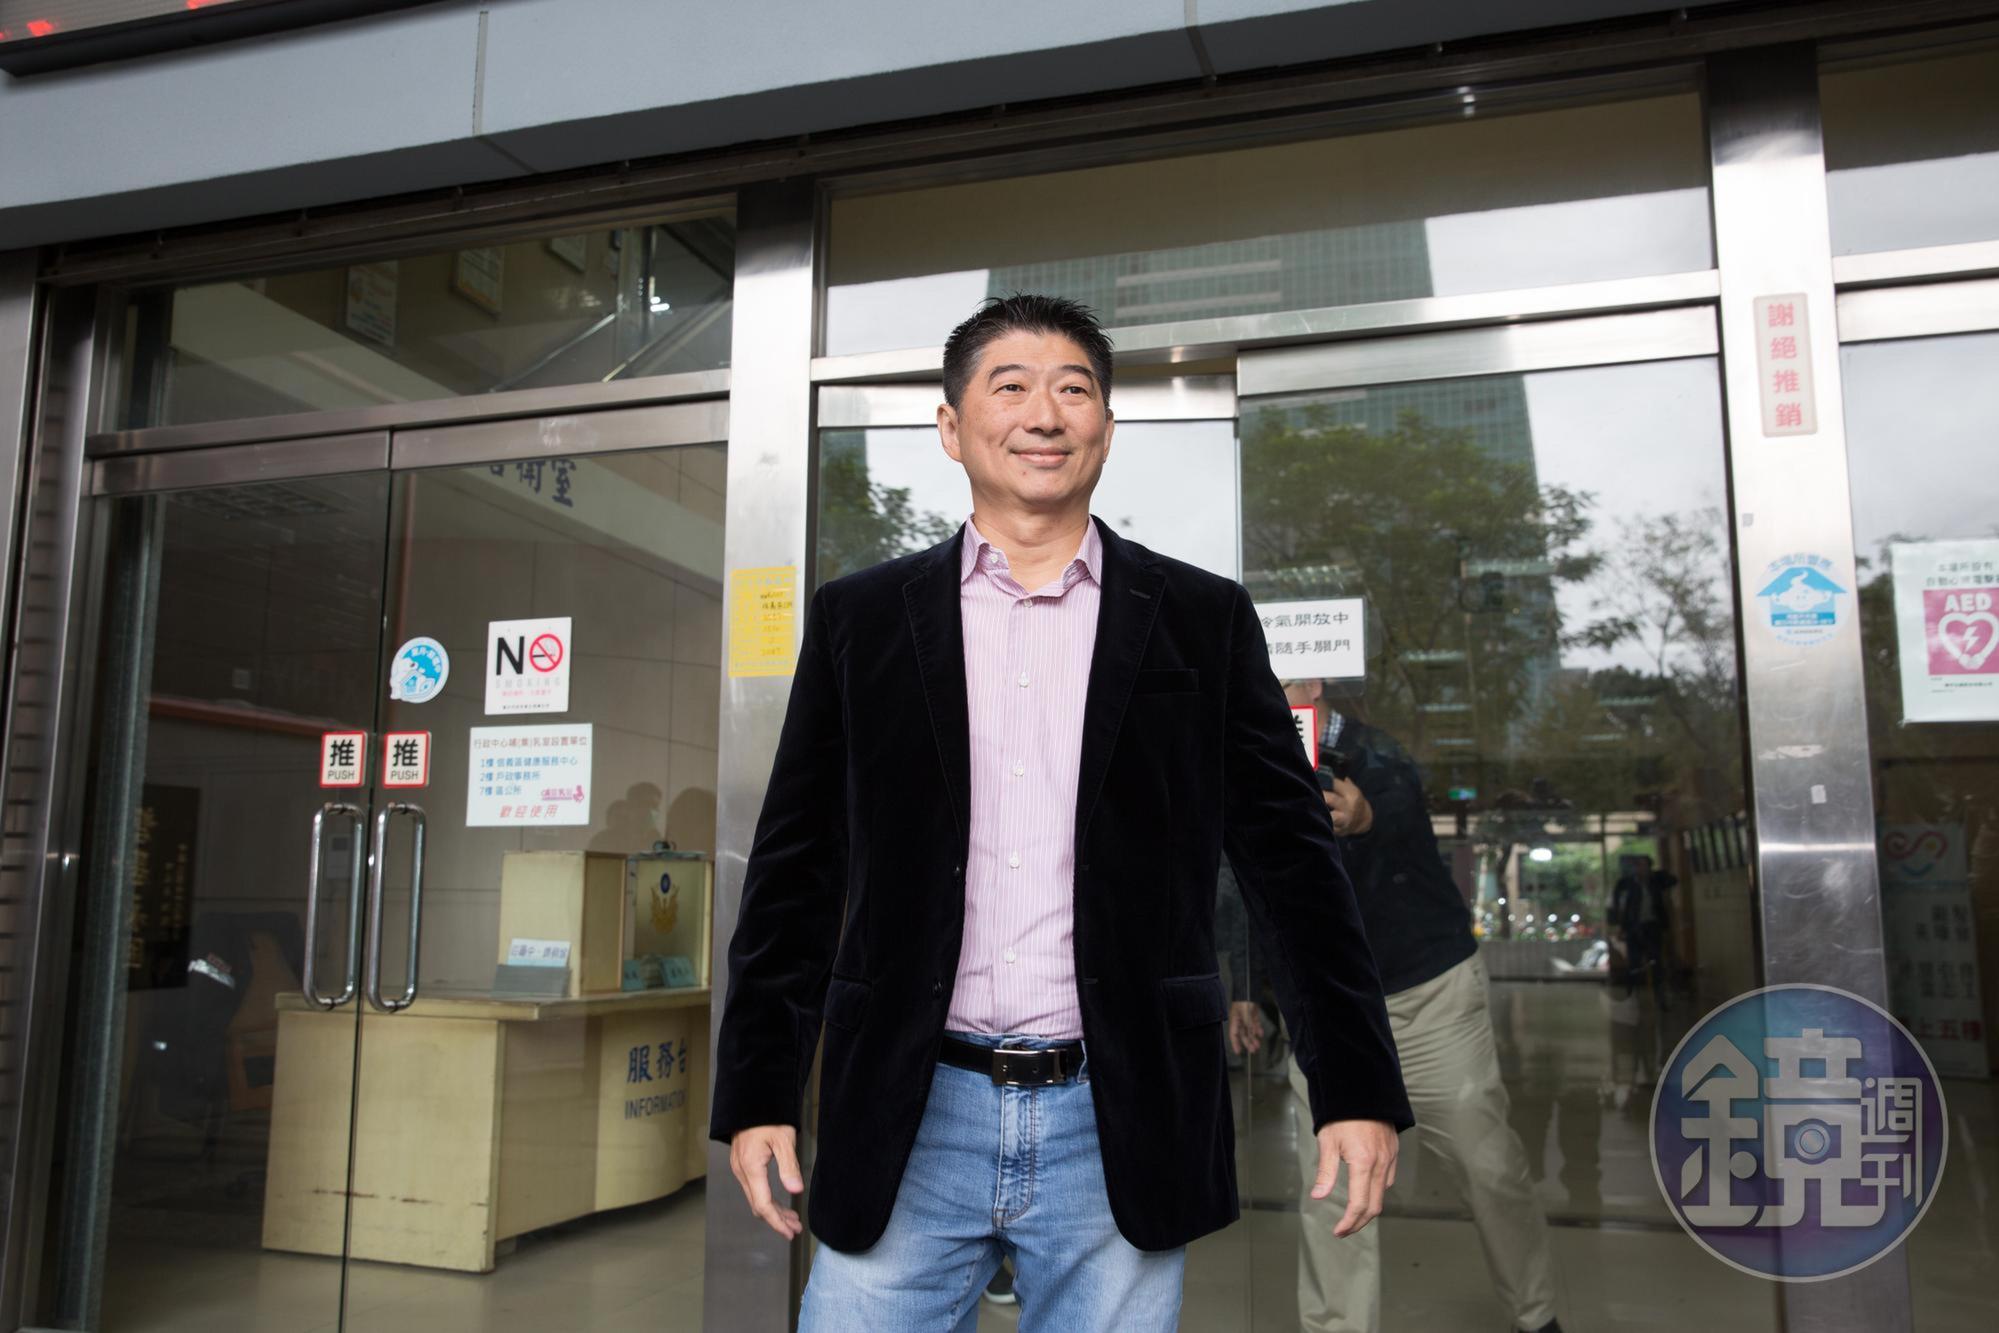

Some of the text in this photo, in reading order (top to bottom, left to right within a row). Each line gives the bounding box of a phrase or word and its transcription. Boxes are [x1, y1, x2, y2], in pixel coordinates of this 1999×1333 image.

[1768, 303, 1802, 428] 謝絕推銷
[1944, 593, 1992, 613] AED
[1262, 612, 1349, 628] 冷氣開放中
[330, 739, 355, 766] 推
[393, 739, 418, 766] 推
[480, 758, 494, 768] 1樓
[328, 770, 355, 780] PUSH
[391, 770, 419, 780] PUSH
[480, 772, 493, 781] 2樓
[500, 805, 558, 818] 歡迎使用
